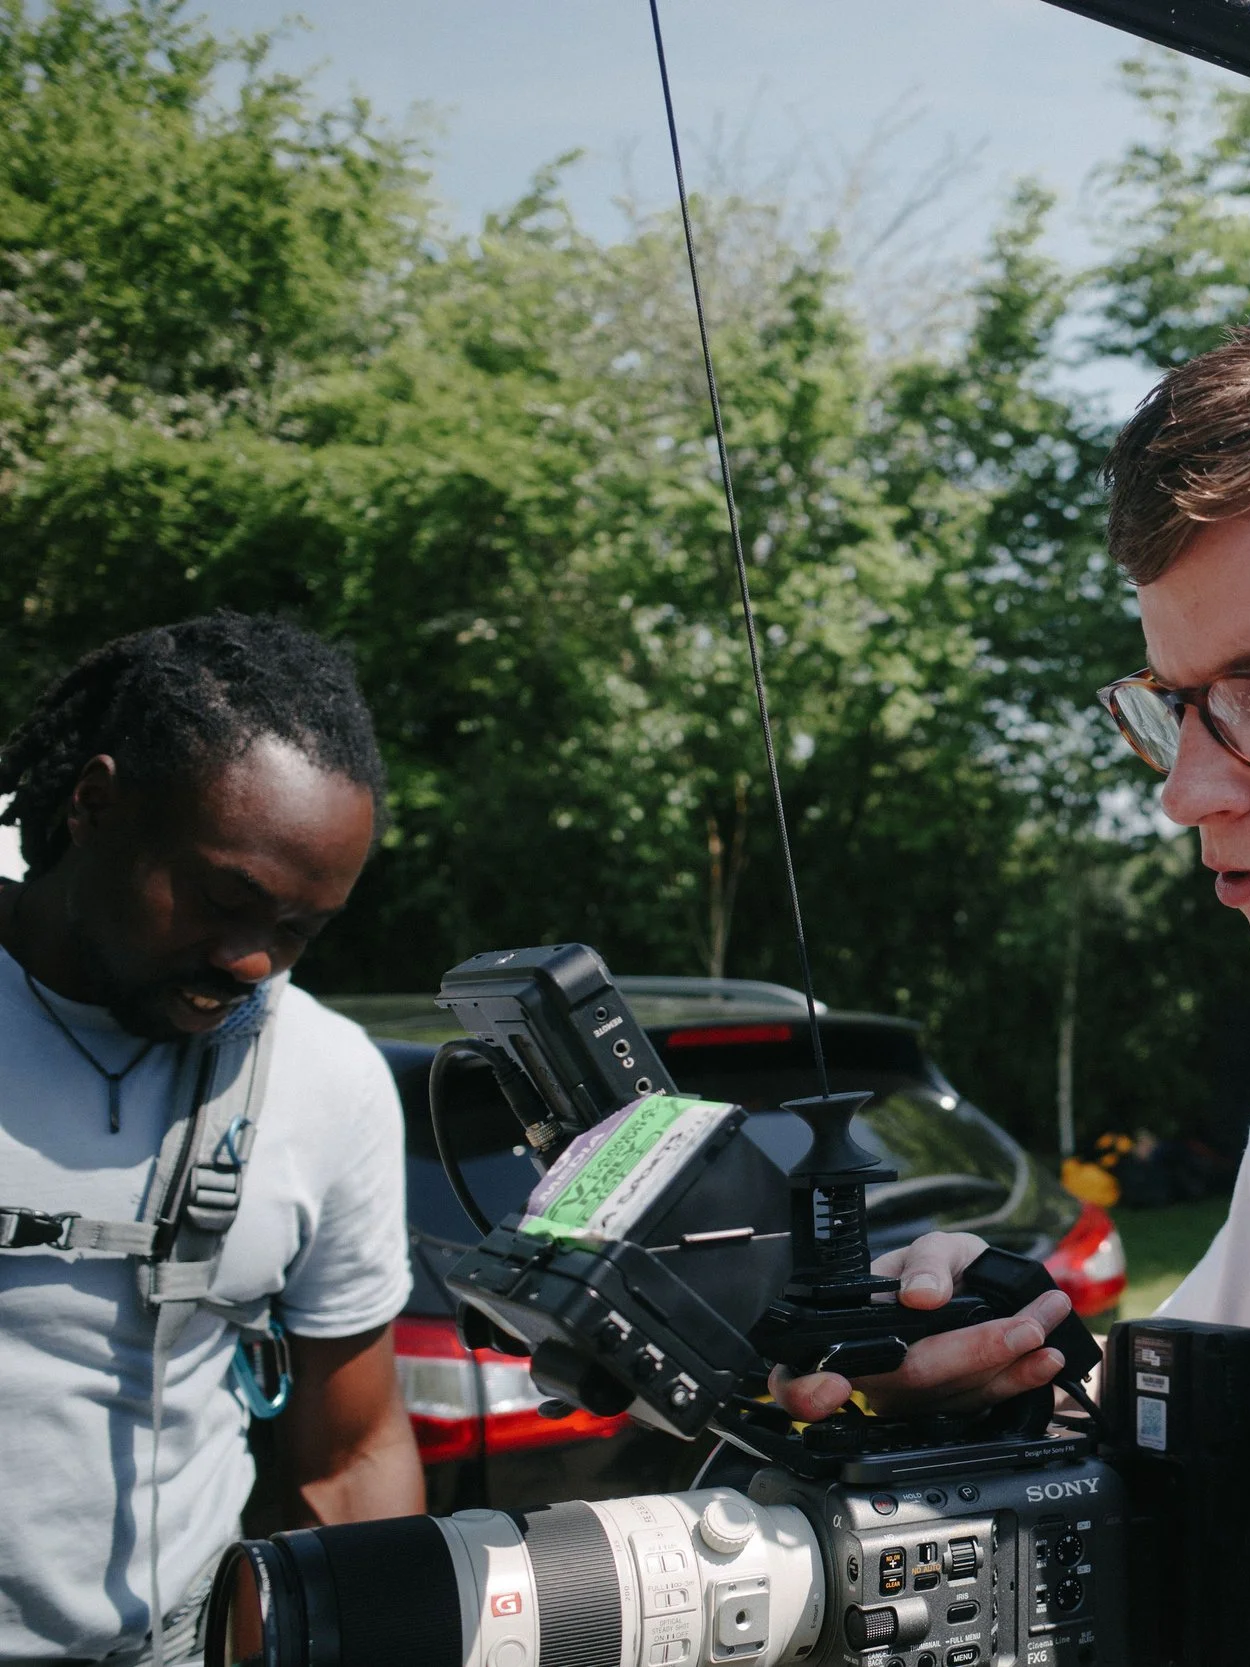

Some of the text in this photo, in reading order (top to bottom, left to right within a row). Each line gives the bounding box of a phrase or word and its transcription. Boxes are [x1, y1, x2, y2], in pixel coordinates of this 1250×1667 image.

[593, 1016, 623, 1039] REMOTE
[537, 1129, 605, 1203] MEDIA
[1024, 1449, 1041, 1457] Design
[1051, 1446, 1064, 1455] Sony
[1025, 1477, 1100, 1502] SONY
[902, 1492, 922, 1500] HOLD
[923, 1564, 942, 1574] AUTO
[956, 1592, 969, 1600] IRIS
[496, 1595, 517, 1614] G
[659, 1618, 681, 1626] OPTICAL
[652, 1626, 673, 1634] STEADY
[950, 1632, 981, 1644] FULL MENU
[1027, 1635, 1071, 1650] Cinema Line
[867, 1658, 883, 1667] BACK
[953, 1652, 973, 1663] MENU
[1027, 1651, 1047, 1664] FX6
